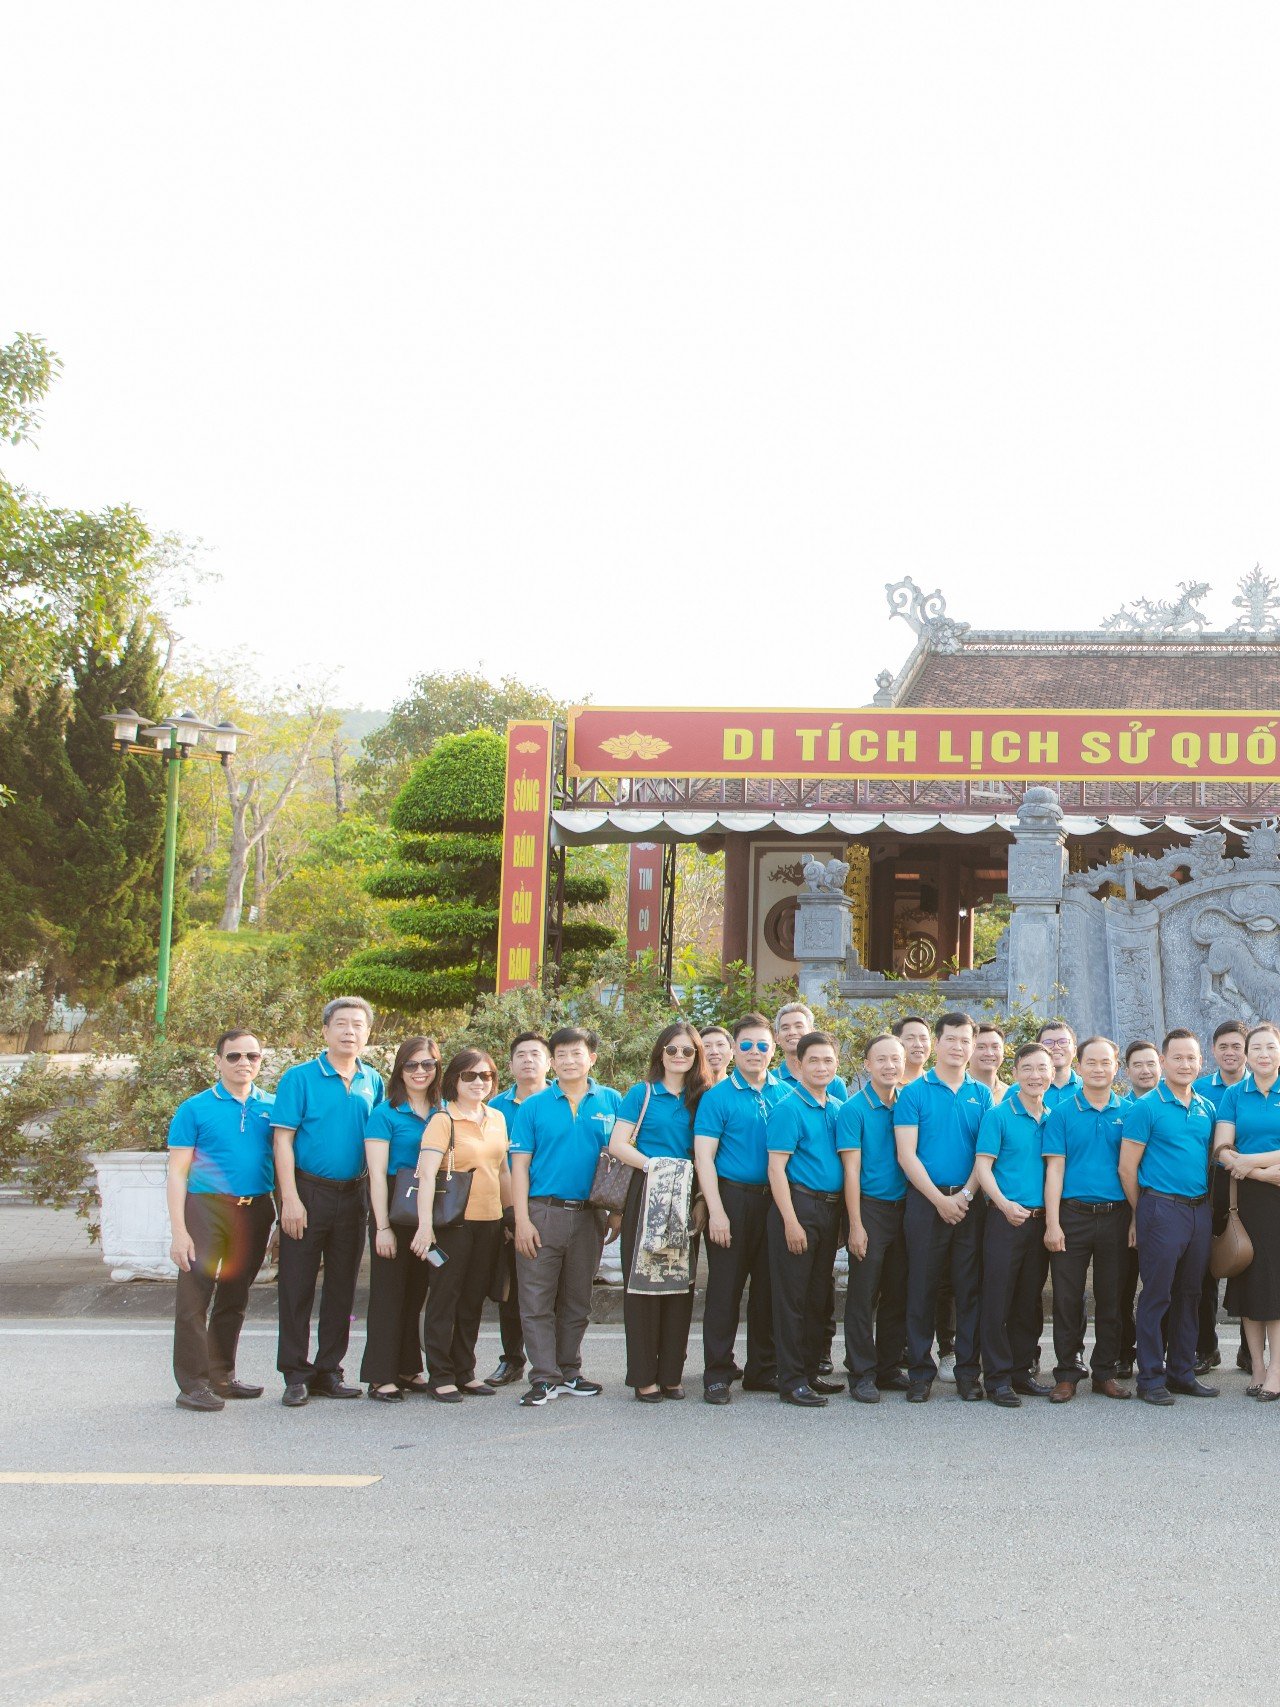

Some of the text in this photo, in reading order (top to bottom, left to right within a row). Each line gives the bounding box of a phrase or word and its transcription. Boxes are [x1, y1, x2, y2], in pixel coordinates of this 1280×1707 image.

[722, 728, 775, 761] DI
[795, 722, 917, 763] TÍCH
[938, 730, 1059, 771] LỊCH
[1080, 721, 1156, 765] SỬ
[513, 768, 540, 813] SỐNG
[512, 829, 536, 868] BÁM
[638, 868, 653, 890] TIM
[511, 880, 533, 925] CẦU
[638, 905, 650, 932] CÓ
[508, 942, 531, 981] BÁM
